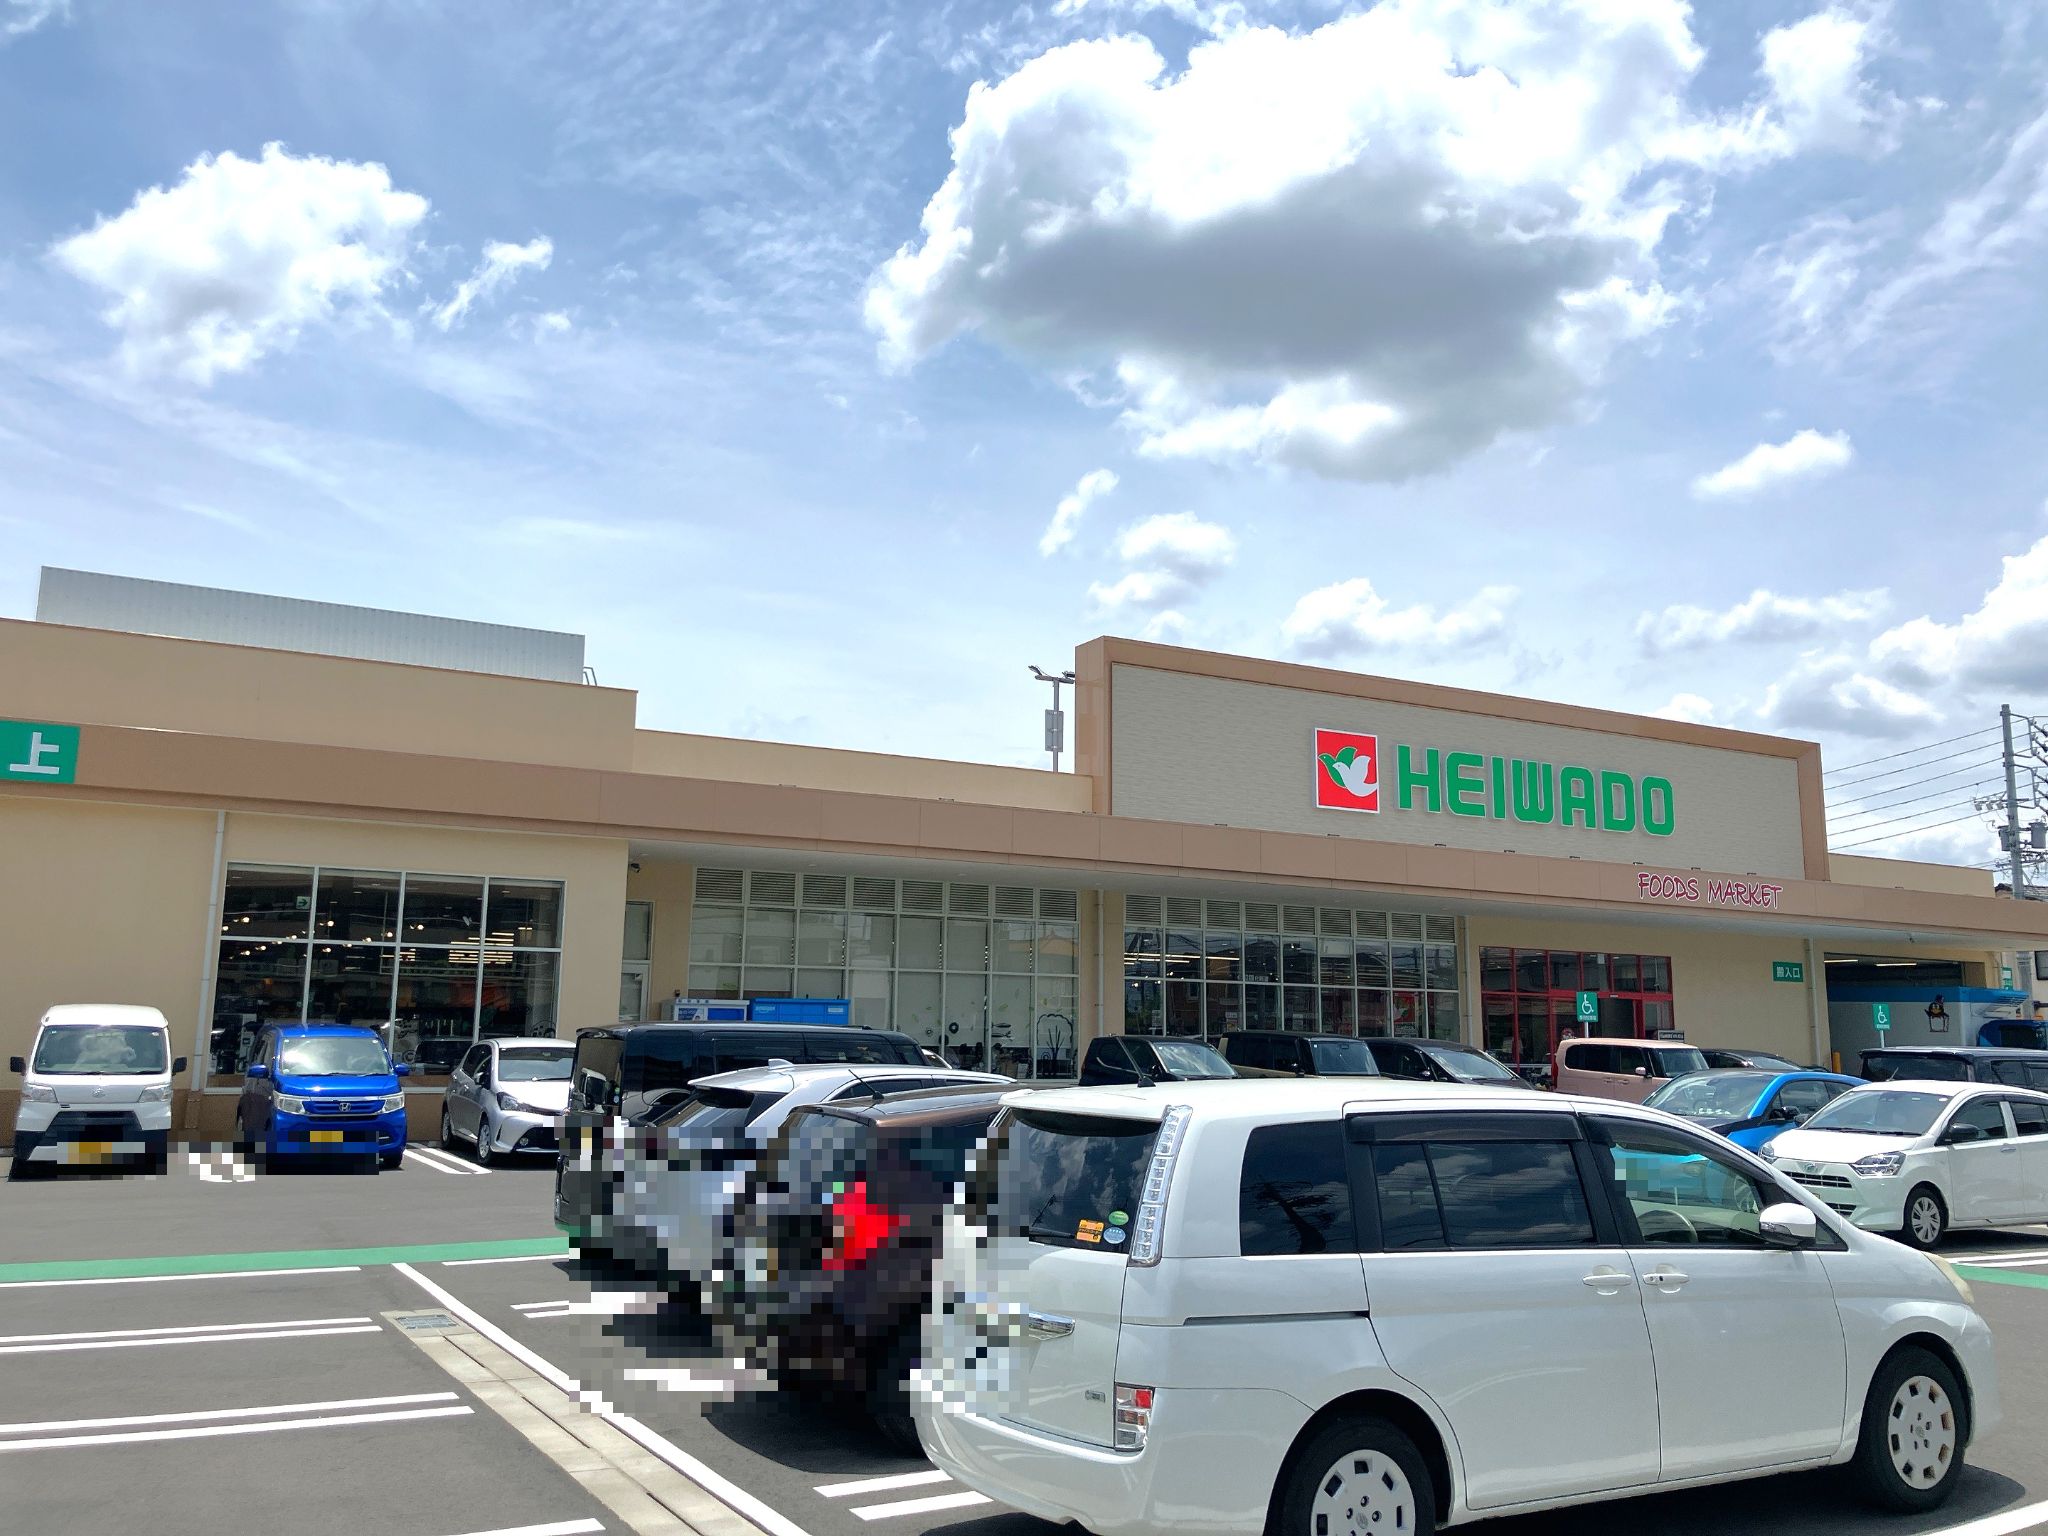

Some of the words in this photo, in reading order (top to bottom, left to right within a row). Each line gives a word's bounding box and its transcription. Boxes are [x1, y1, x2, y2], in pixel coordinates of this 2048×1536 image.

[10, 732, 59, 774] 上
[1397, 744, 1675, 836] HEIWADO
[1638, 872, 1699, 901] FOODS
[1707, 879, 1783, 909] MARKET
